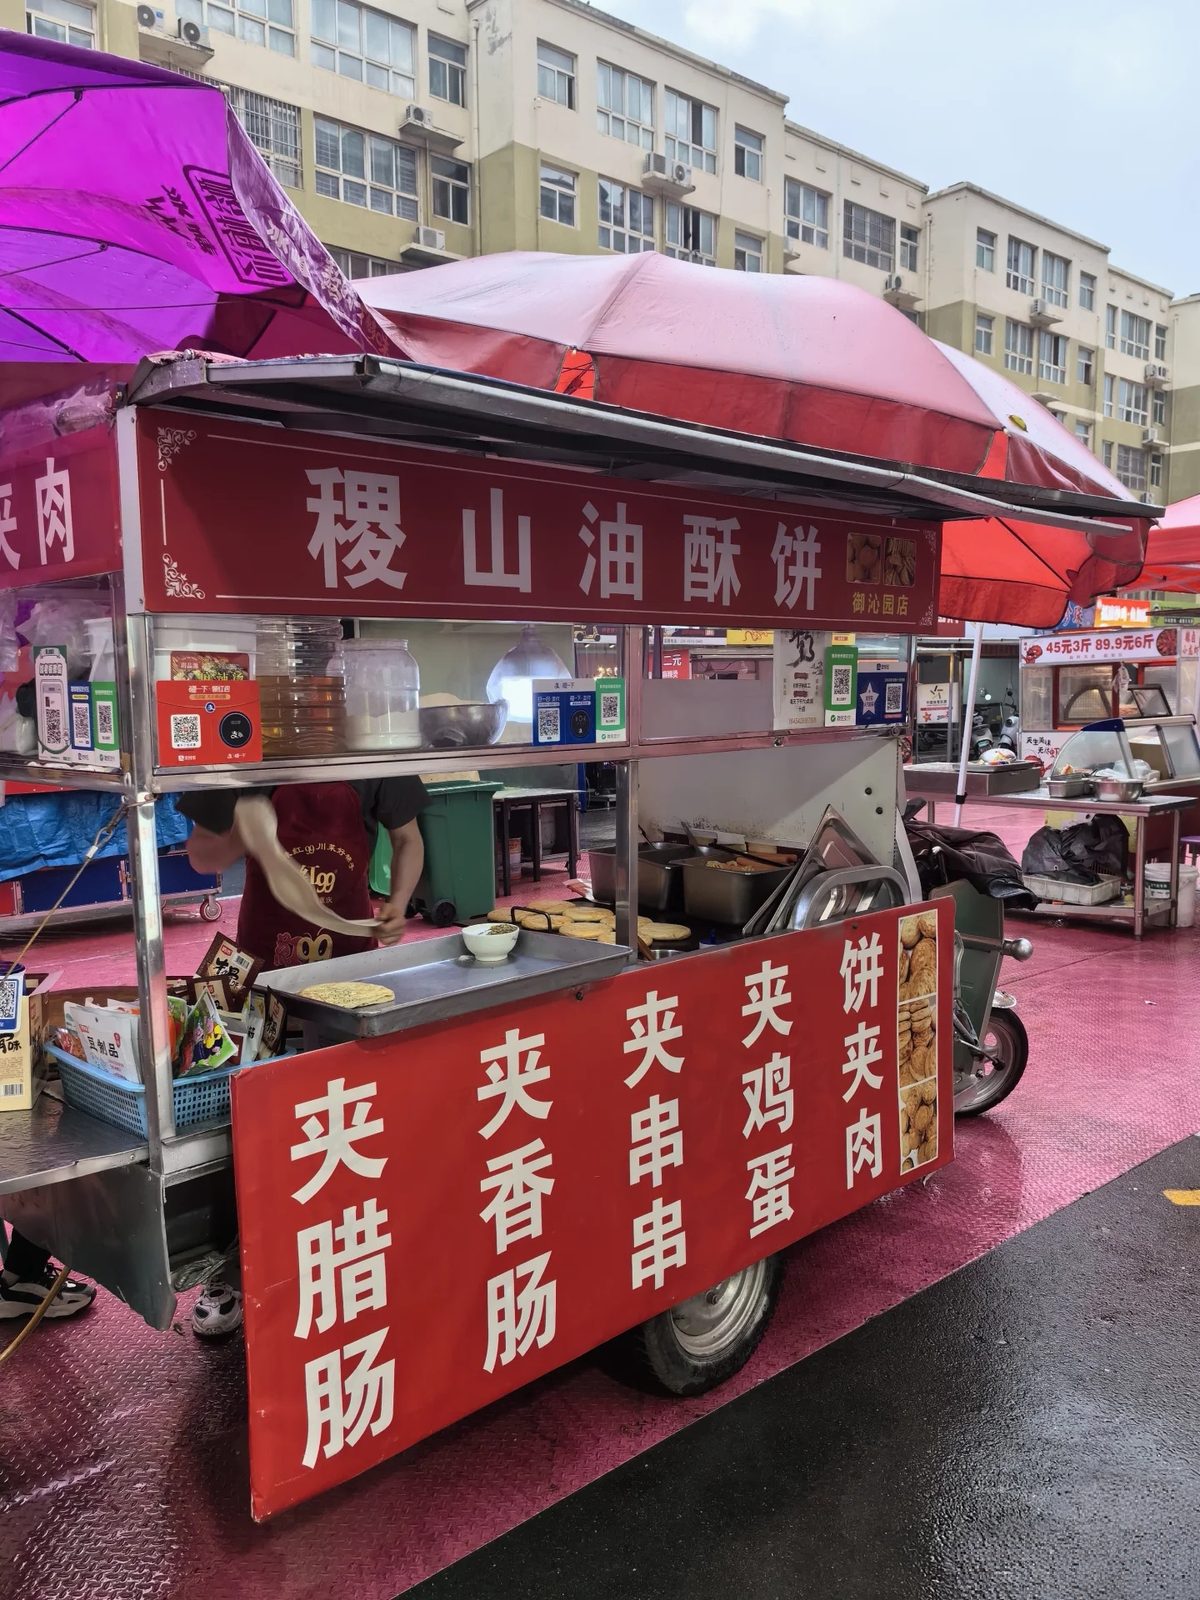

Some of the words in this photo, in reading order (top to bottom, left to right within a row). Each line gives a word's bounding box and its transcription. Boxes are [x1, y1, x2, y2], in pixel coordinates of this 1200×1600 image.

[304, 465, 823, 611] 稷山油酥饼
[852, 592, 909, 616] 御沁园店
[1046, 638, 1092, 654] 45元3斤
[1095, 633, 1155, 651] 89.9元6斤
[623, 989, 686, 1291] 夹串串
[740, 959, 796, 1240] 夹鸡蛋
[839, 931, 885, 1190] 饼夹肉
[290, 1076, 396, 1470] 夹腊肠
[477, 1027, 558, 1375] 夹香肠
